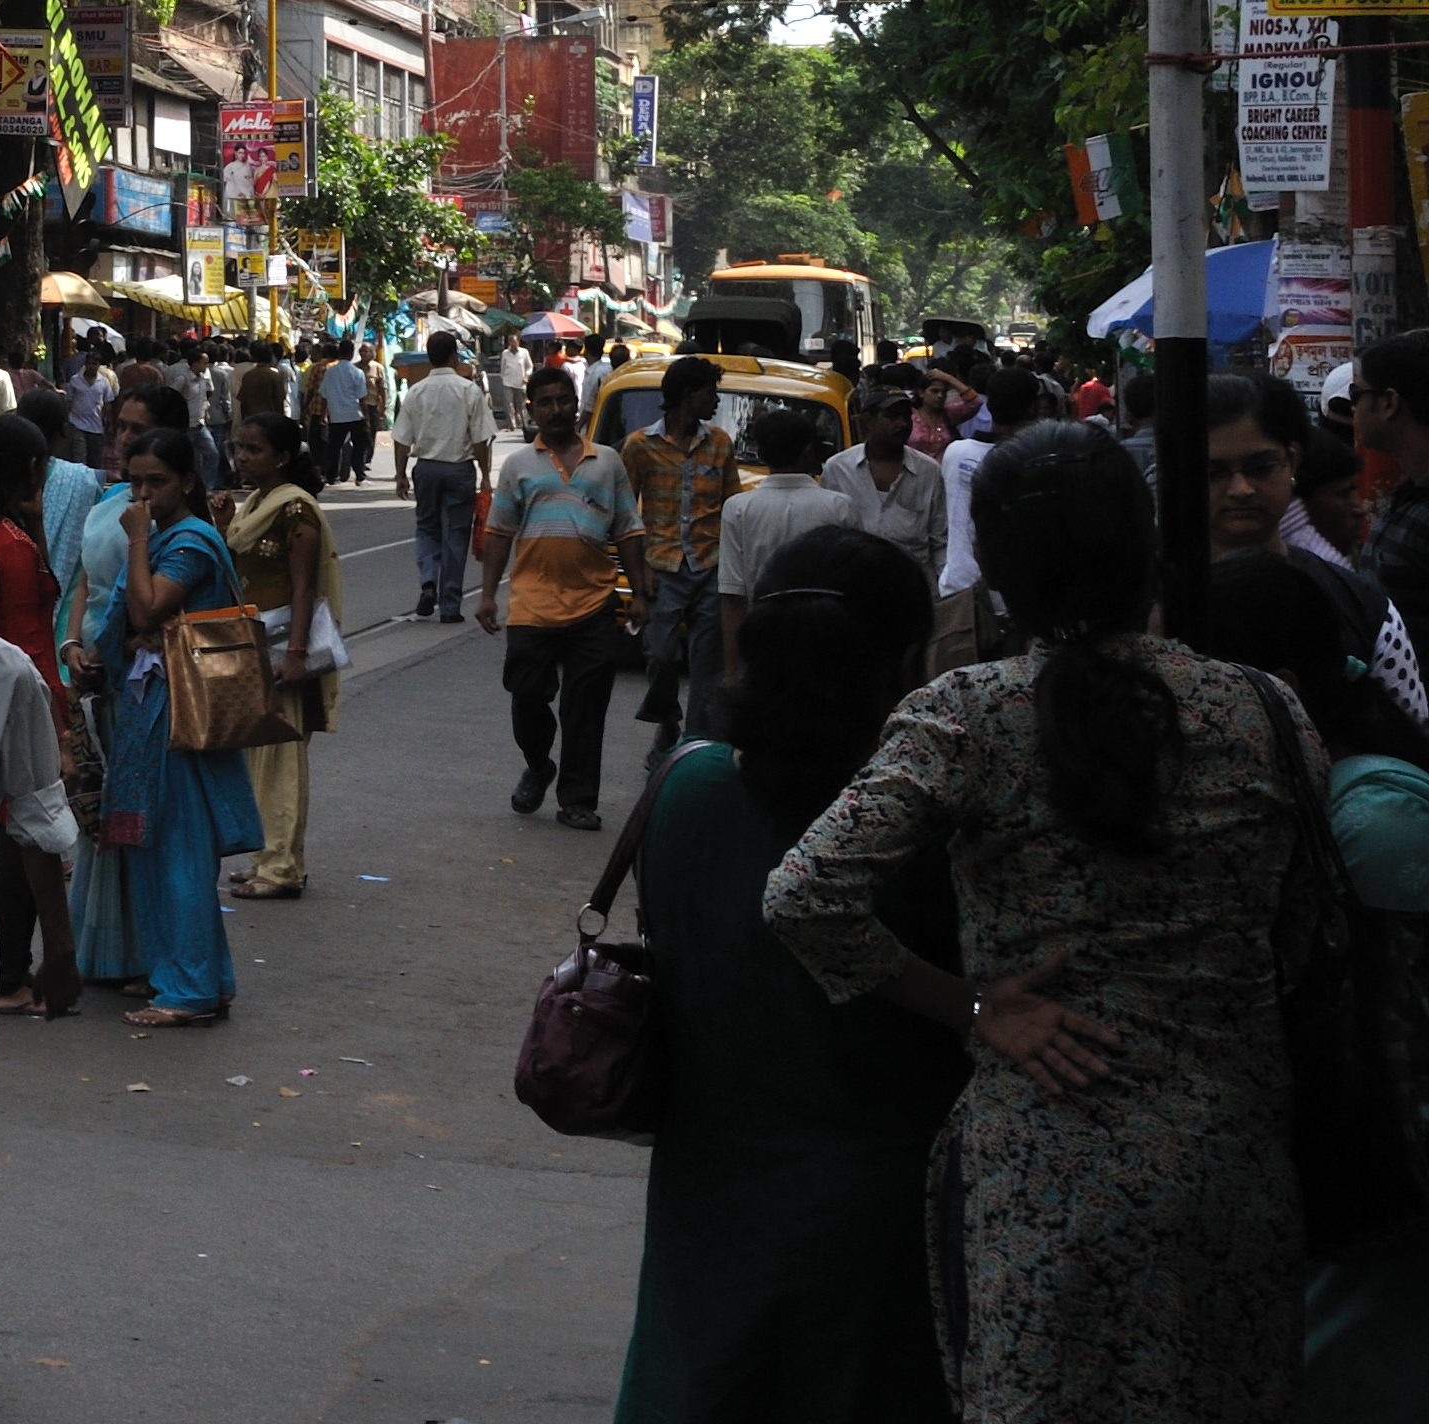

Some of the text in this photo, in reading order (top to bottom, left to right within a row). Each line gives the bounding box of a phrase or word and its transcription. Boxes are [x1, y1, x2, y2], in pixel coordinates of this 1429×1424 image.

[76, 30, 106, 42] SMU
[1249, 17, 1303, 38] NIOS-X,
[1263, 60, 1307, 71] (Regular)
[1251, 72, 1321, 89] IGNOU
[58, 27, 111, 164] MOHAN
[224, 111, 273, 133] Mala
[1247, 107, 1320, 124] BRIGHT CAREER
[1241, 124, 1327, 141] COACHING CENTRE
